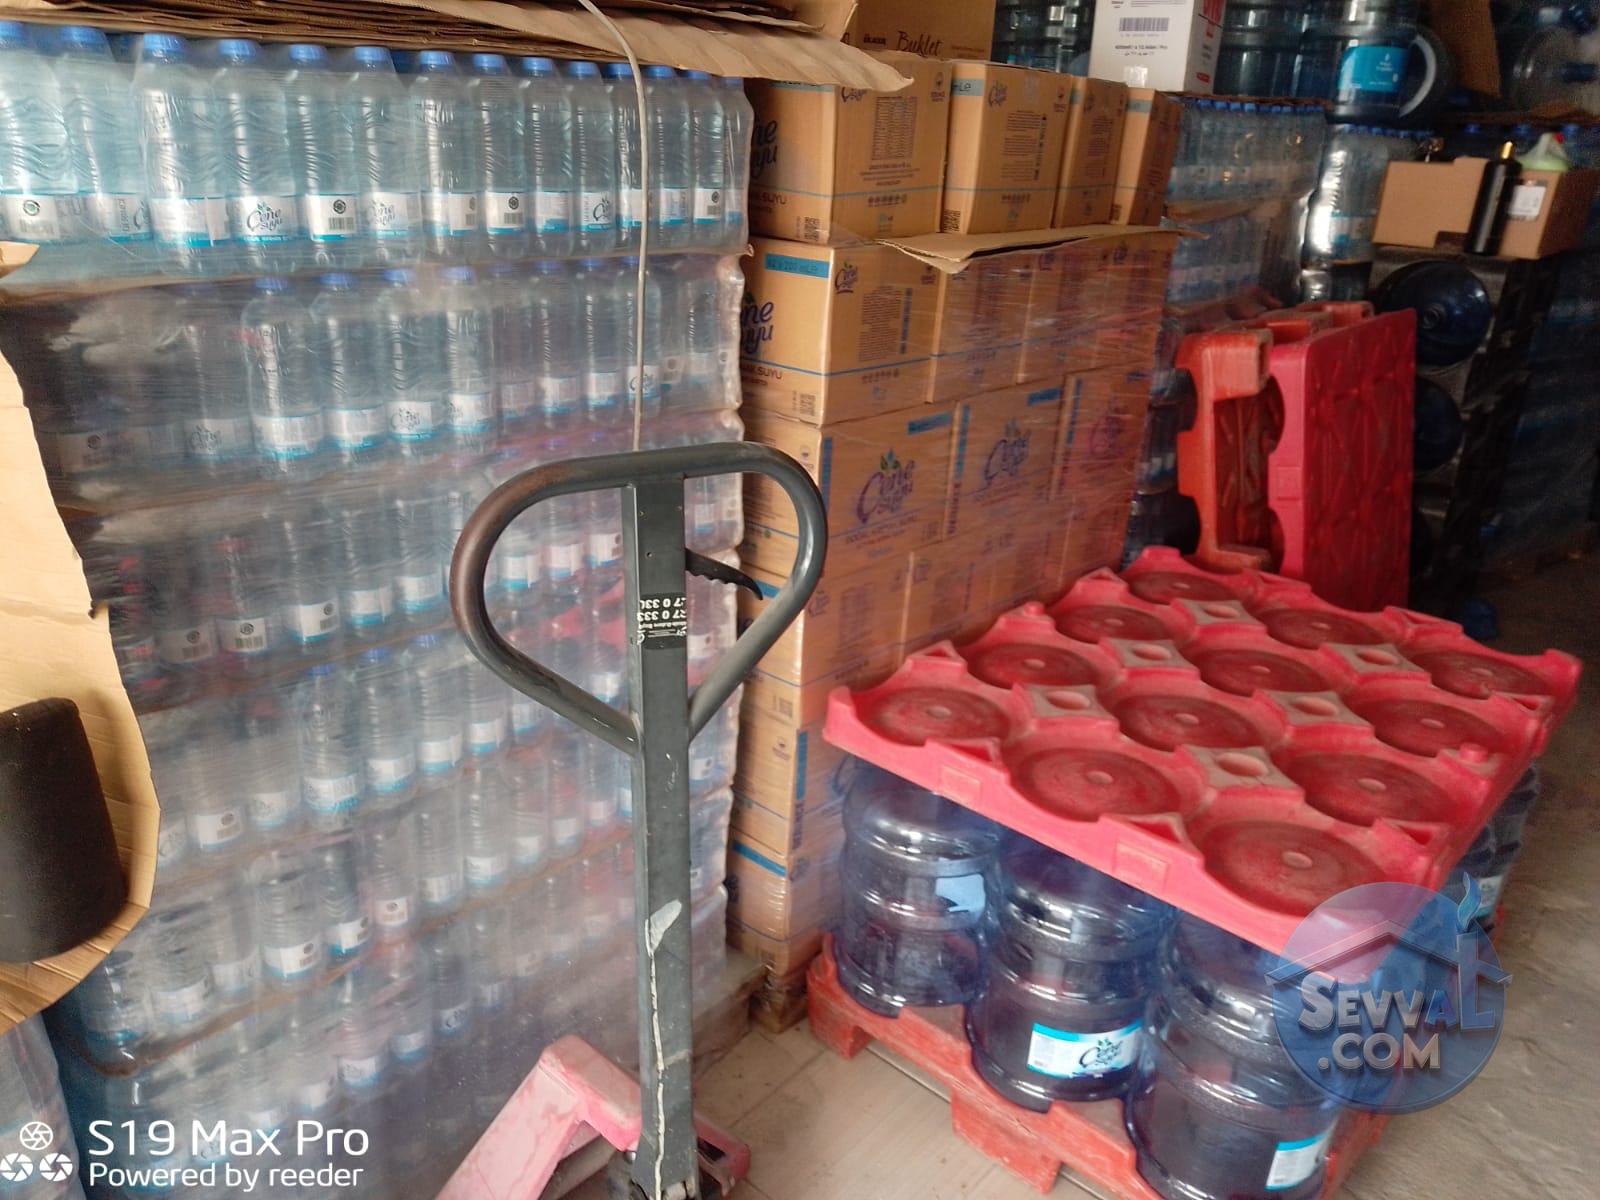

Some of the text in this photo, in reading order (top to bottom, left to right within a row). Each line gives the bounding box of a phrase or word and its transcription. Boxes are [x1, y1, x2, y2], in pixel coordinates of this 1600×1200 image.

[895, 30, 943, 58] Buklet
[741, 301, 775, 327] ne
[662, 598, 671, 608] 0
[661, 610, 670, 619] 0
